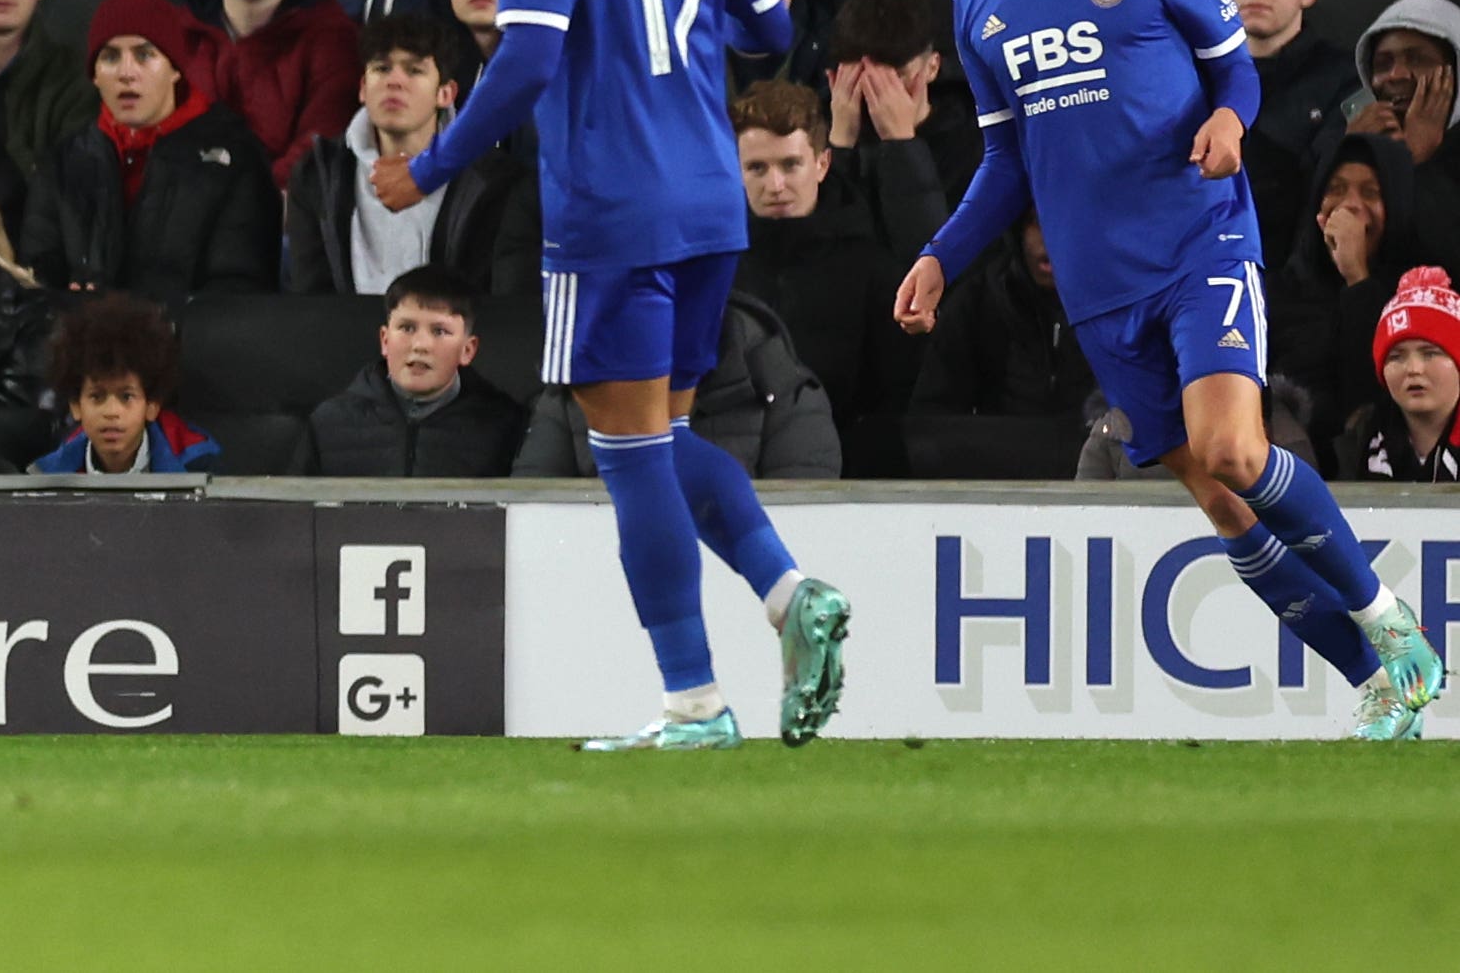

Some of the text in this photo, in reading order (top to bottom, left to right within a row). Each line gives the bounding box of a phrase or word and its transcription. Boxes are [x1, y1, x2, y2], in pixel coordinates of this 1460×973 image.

[1002, 21, 1103, 82] FBS
[1023, 88, 1110, 117] trade online
[1207, 276, 1244, 327] 7
